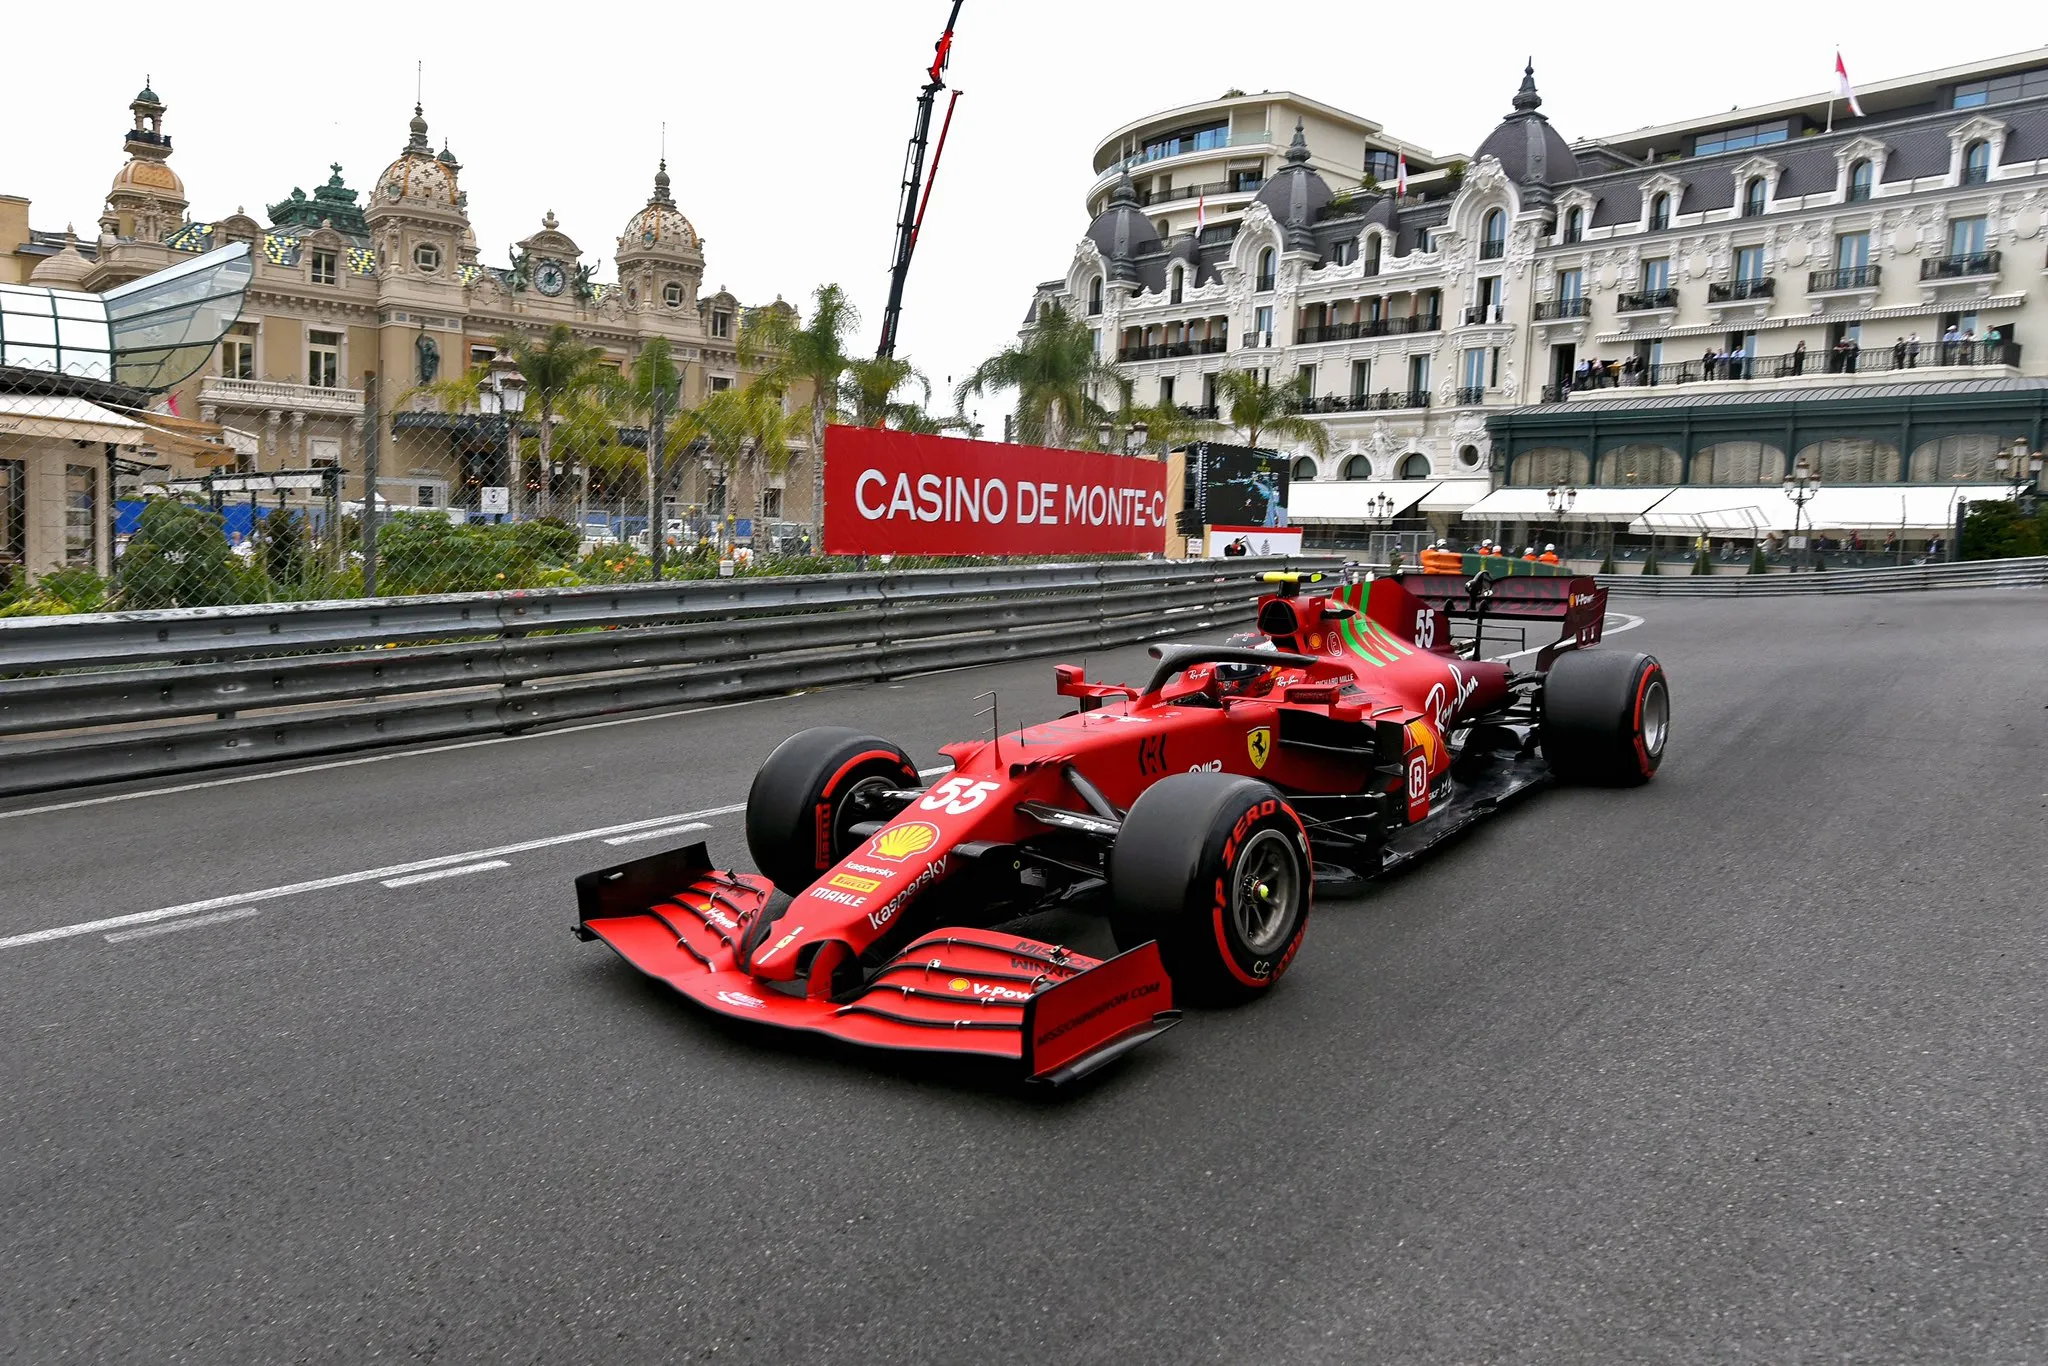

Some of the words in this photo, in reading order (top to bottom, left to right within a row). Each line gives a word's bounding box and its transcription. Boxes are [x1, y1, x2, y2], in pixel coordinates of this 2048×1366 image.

[855, 468, 1008, 525] CASINO
[1017, 481, 1058, 526] DE
[1065, 484, 1167, 528] MONTE-C
[1414, 608, 1435, 649] 55
[919, 777, 1000, 815] 55
[1222, 799, 1276, 870] ZERO
[835, 876, 875, 891] PIRELLI
[844, 861, 897, 879] kaspersky
[809, 887, 868, 907] MAHLE
[867, 854, 947, 930] kaspersky
